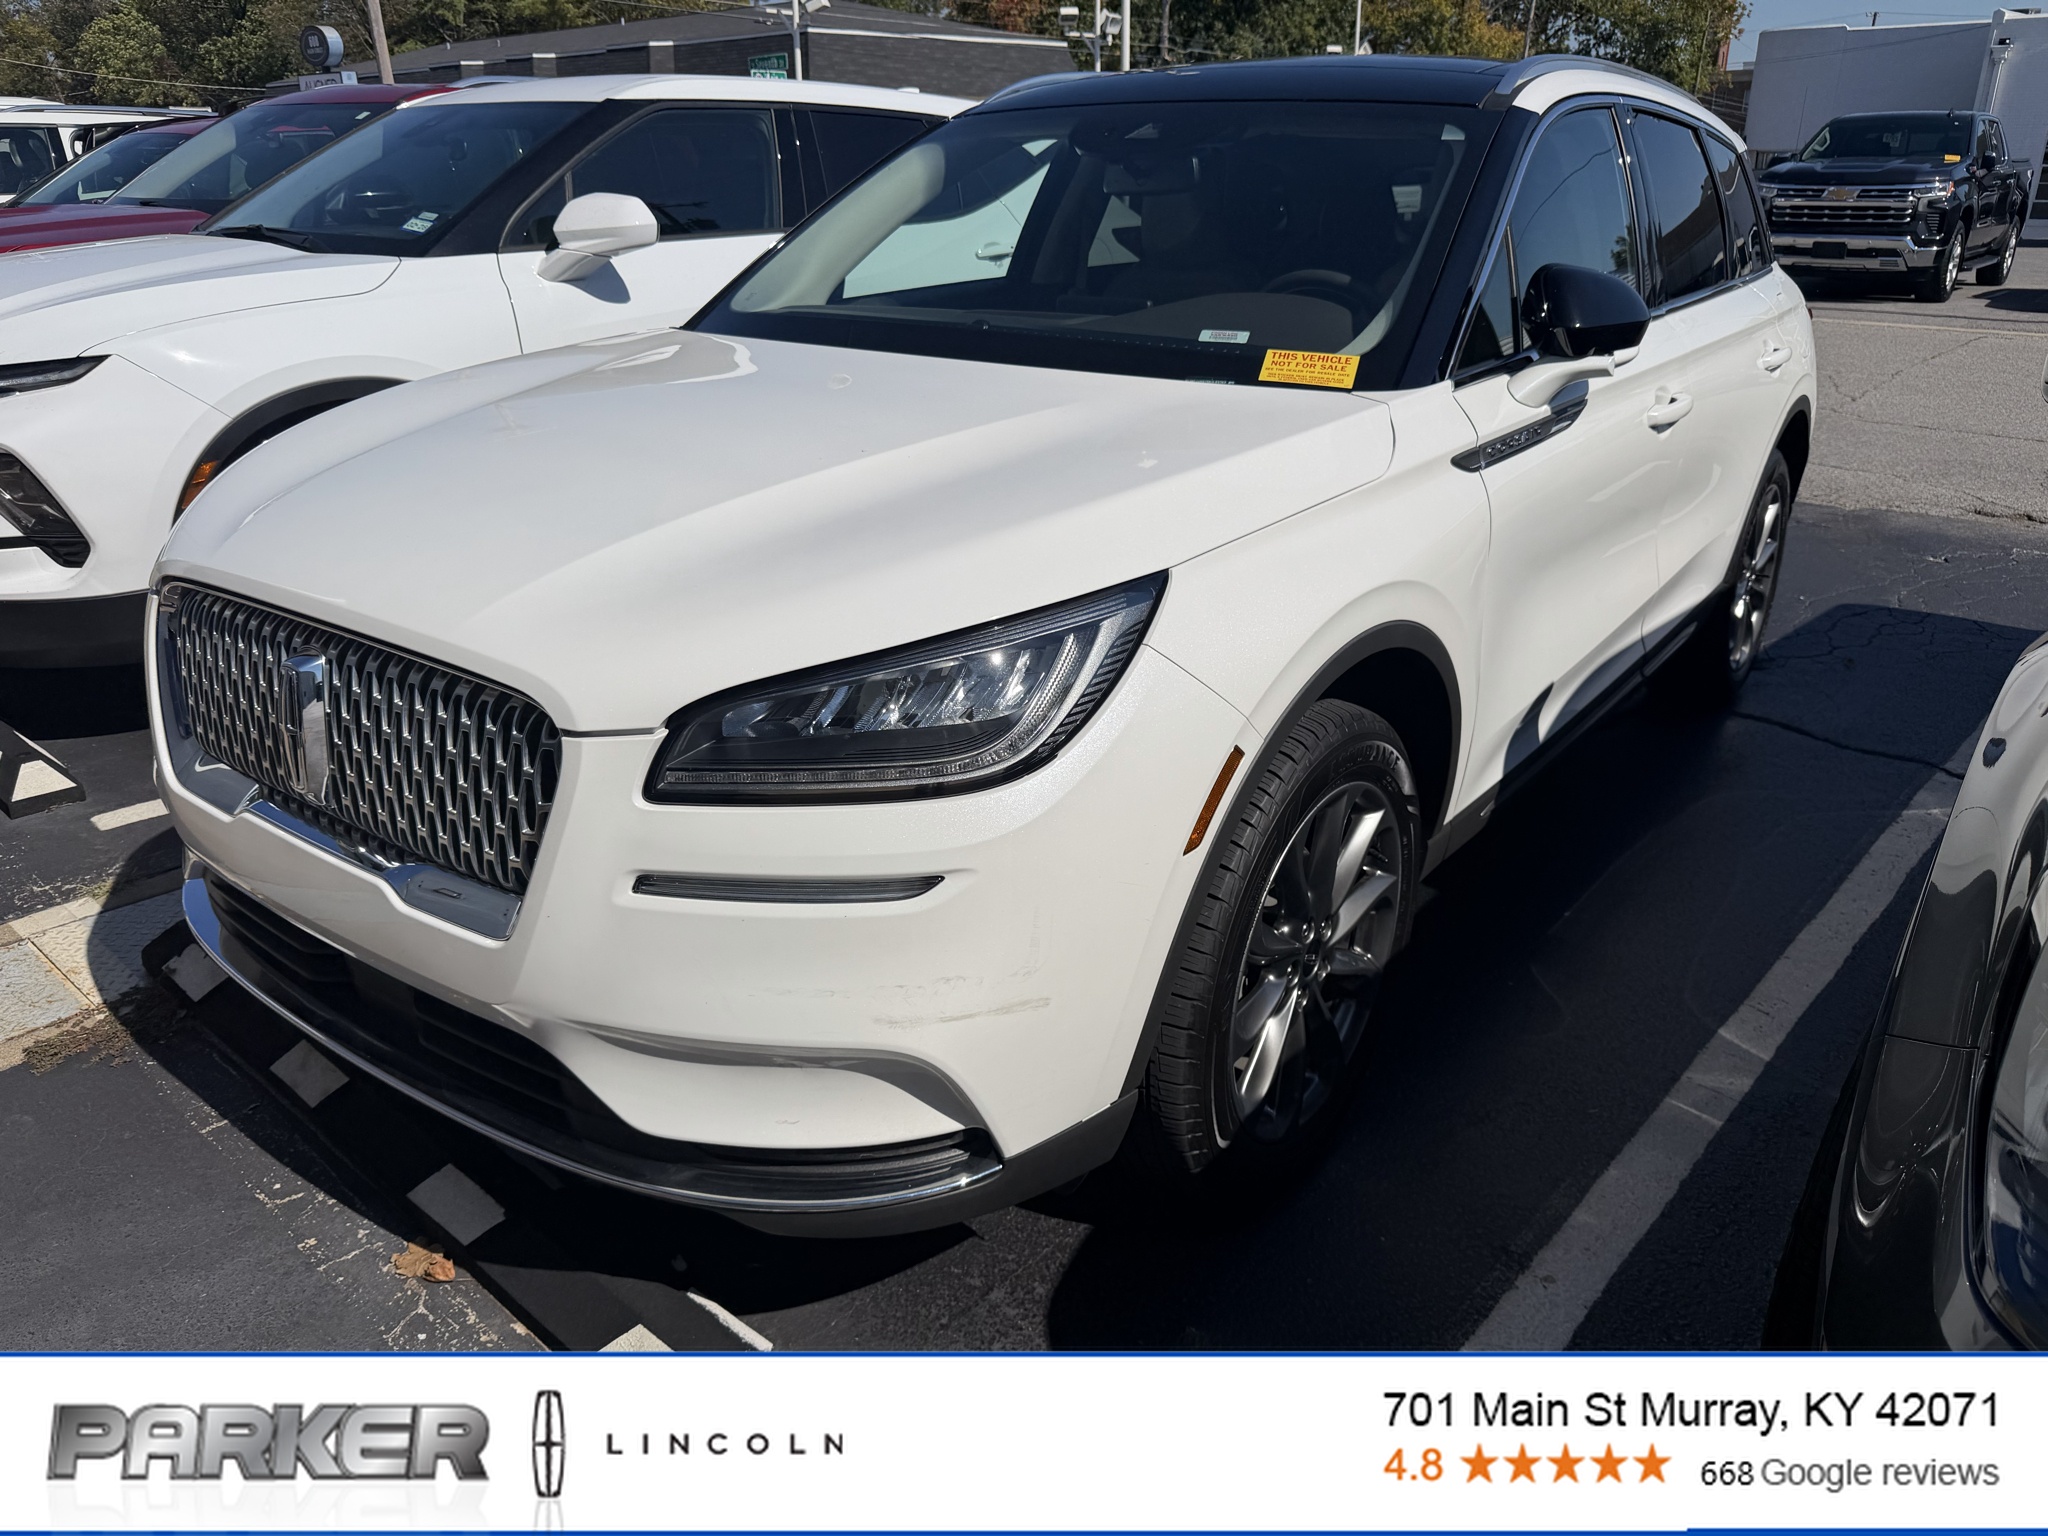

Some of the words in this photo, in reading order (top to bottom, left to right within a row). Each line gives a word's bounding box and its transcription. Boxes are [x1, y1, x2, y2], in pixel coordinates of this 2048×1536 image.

[1271, 351, 1298, 360] THIS
[1301, 353, 1352, 365] VEHICLE
[1320, 364, 1347, 372] SALE
